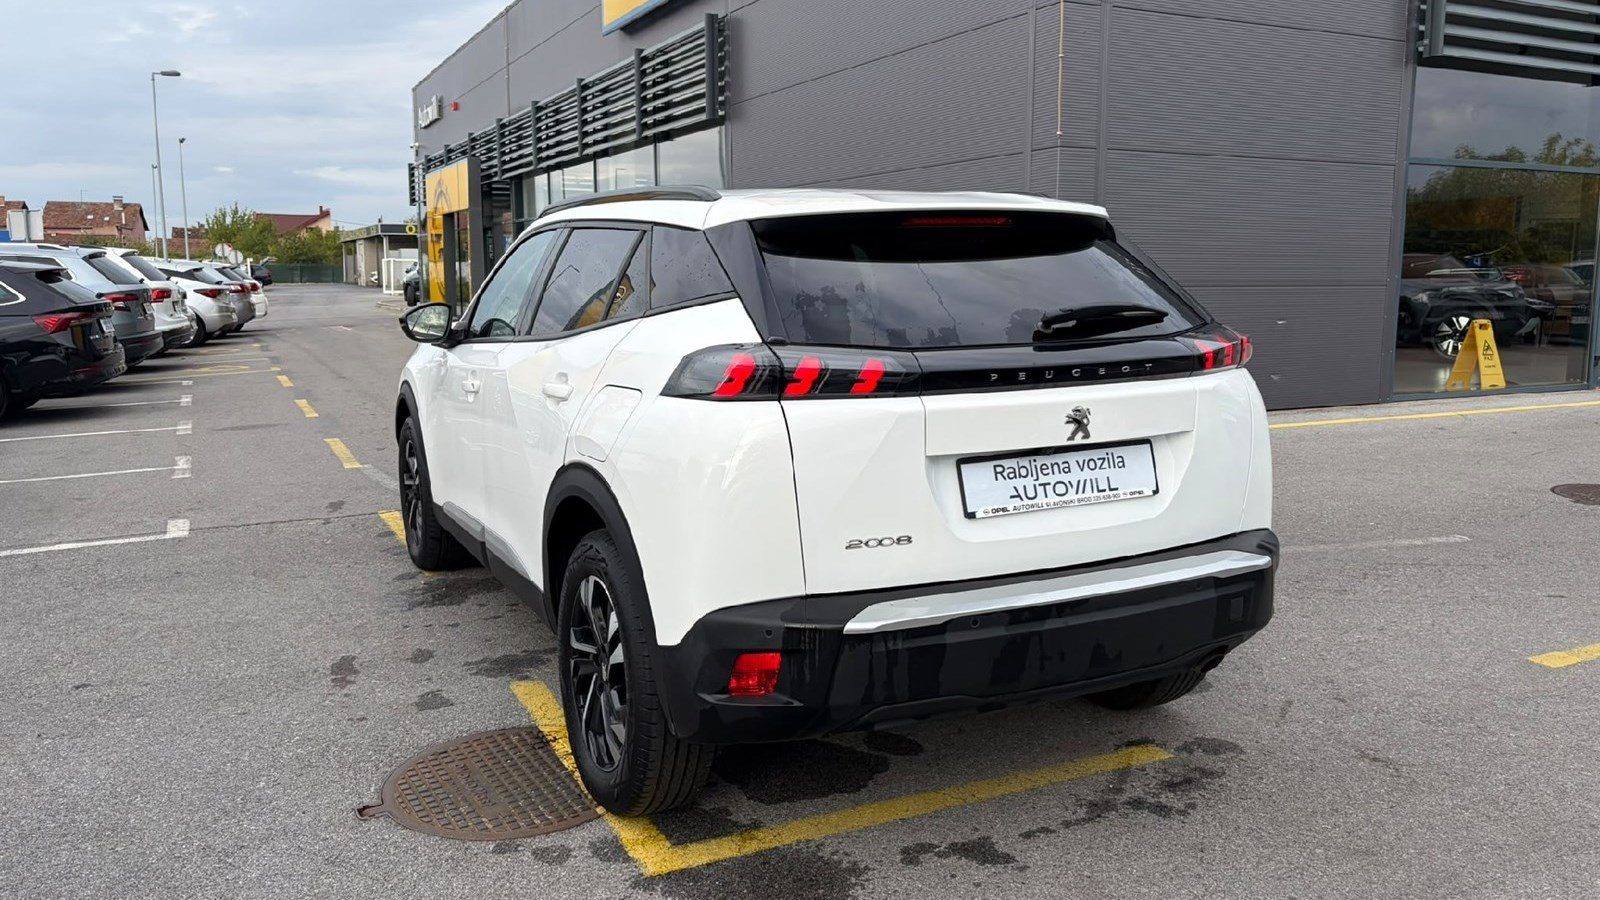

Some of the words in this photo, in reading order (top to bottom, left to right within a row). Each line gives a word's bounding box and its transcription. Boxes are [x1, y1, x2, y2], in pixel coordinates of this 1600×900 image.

[990, 363, 1152, 381] PEUGEOT
[993, 459, 1072, 481] Rabljena
[1076, 452, 1126, 472] vozila
[1010, 477, 1119, 501] AUTOWILL
[1012, 503, 1044, 511] AUTOWILL
[845, 535, 913, 549] 2008
